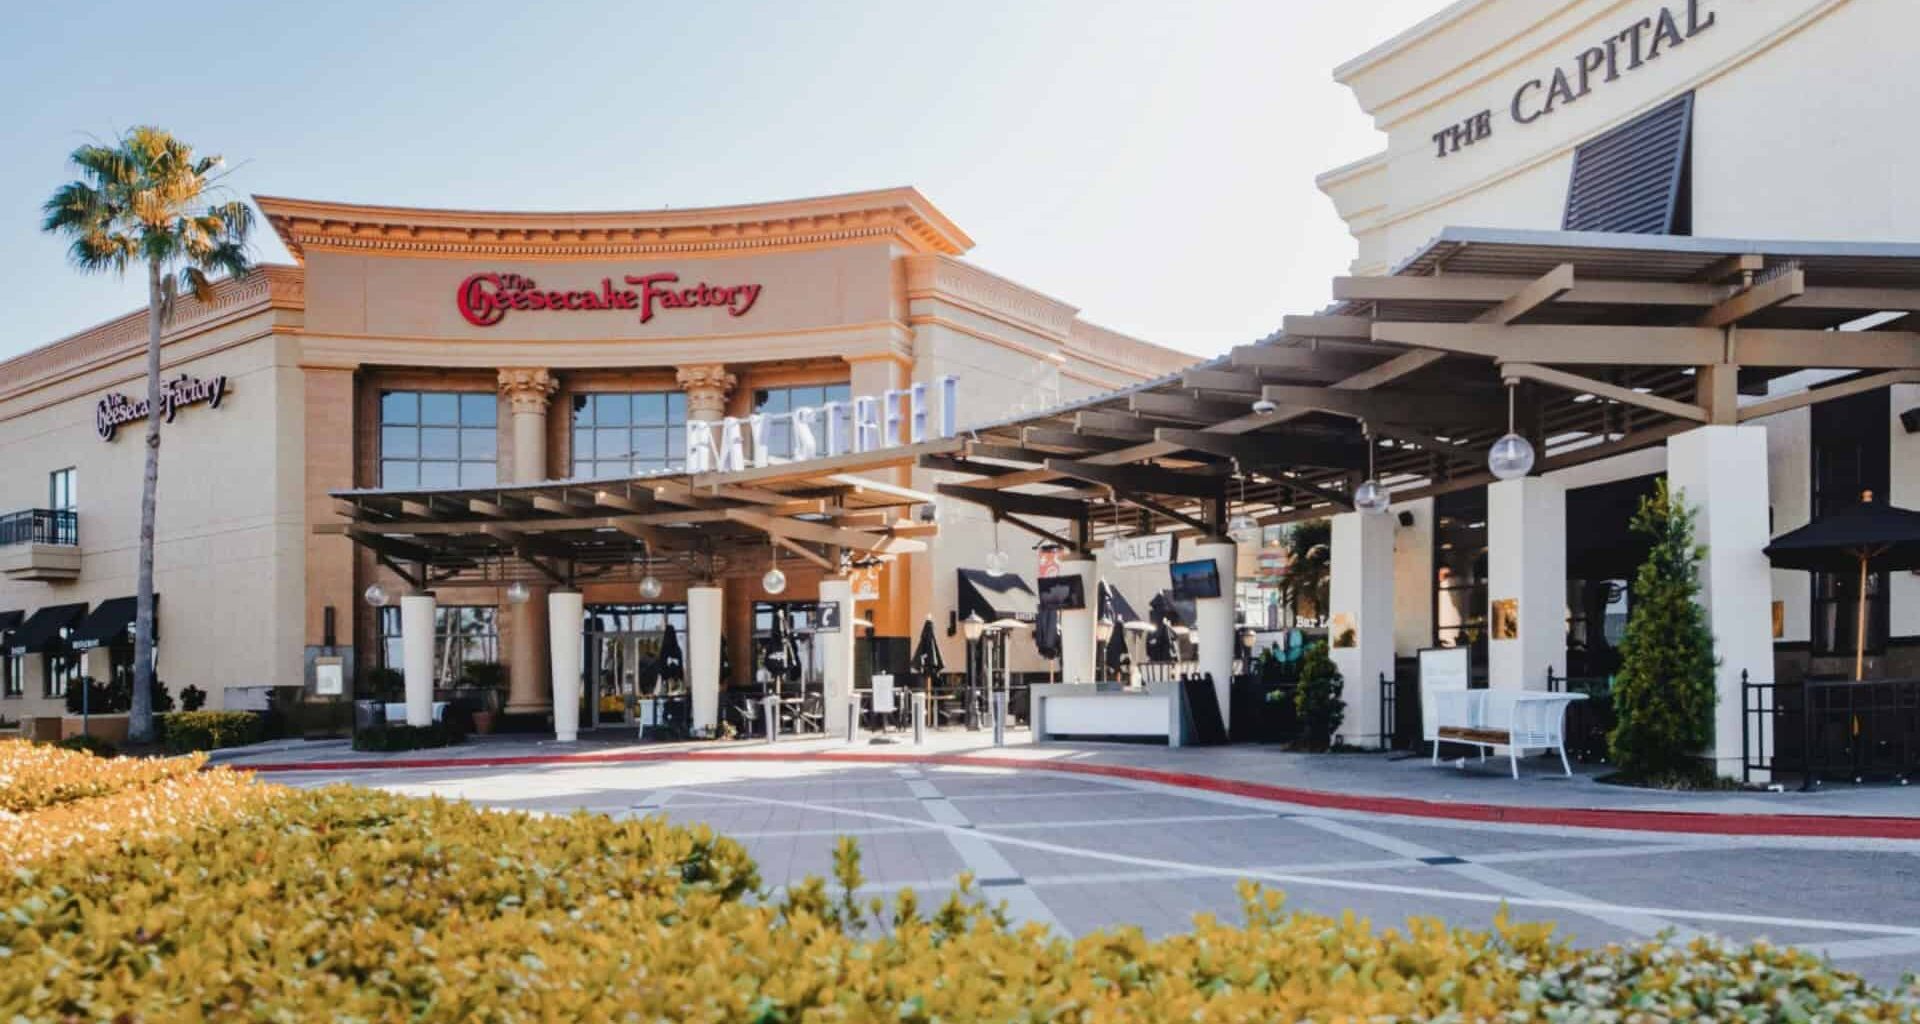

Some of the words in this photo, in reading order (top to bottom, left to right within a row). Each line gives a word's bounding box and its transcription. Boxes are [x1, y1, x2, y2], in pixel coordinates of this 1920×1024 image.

[1432, 109, 1492, 158] THE
[1510, 0, 1716, 124] CAPITAL
[457, 272, 638, 326] Cheesecake
[624, 272, 762, 324] Factory
[500, 273, 536, 290] The
[96, 394, 167, 441] Cheesecae
[160, 374, 227, 423] Factory
[685, 413, 771, 473] BAY
[792, 374, 960, 462] STREET
[1114, 538, 1168, 562] ALET
